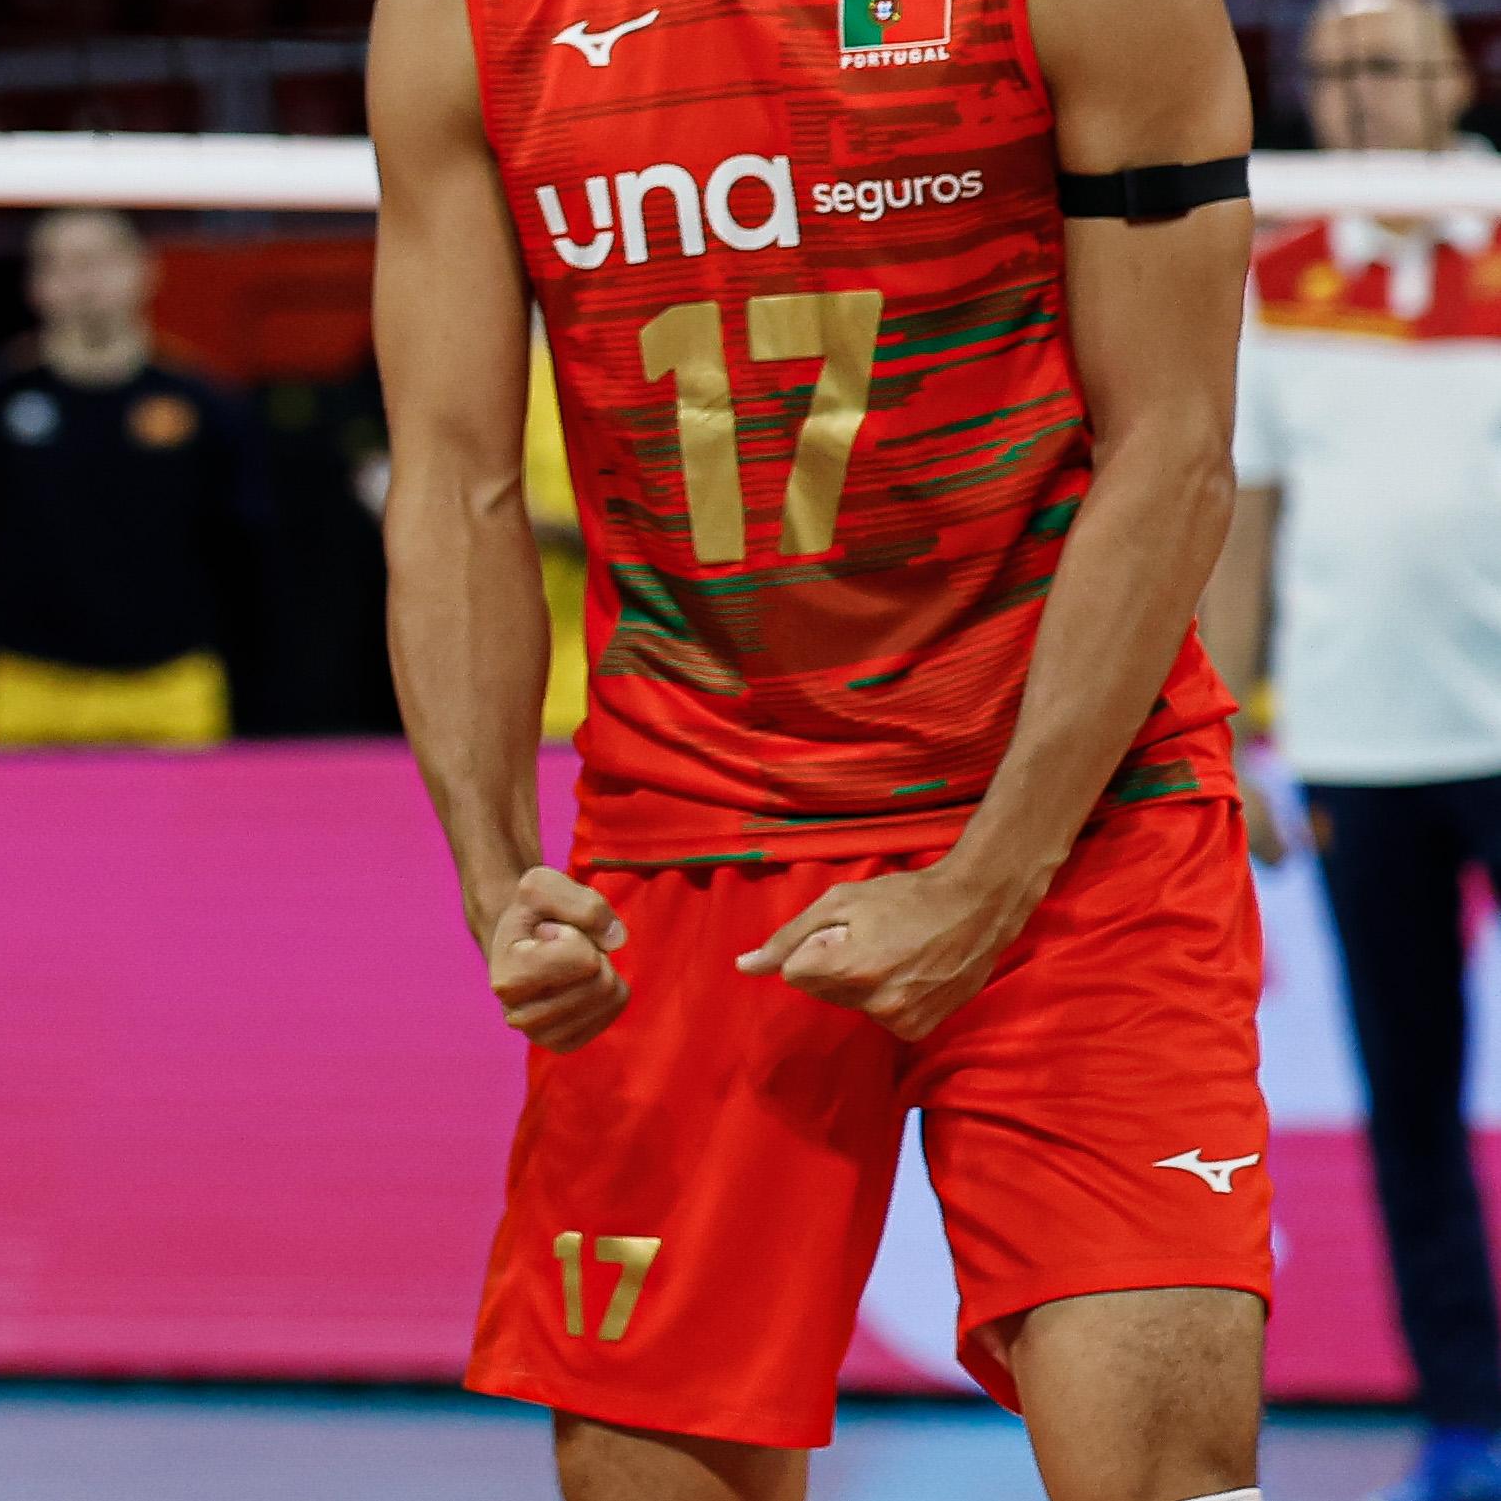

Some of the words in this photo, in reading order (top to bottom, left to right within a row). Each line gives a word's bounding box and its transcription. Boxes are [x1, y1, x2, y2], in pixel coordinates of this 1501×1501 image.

[839, 45, 950, 71] PORTUGAL
[535, 154, 800, 270] una
[810, 167, 984, 222] seguros
[638, 288, 885, 565] 17
[553, 1230, 663, 1342] 17
